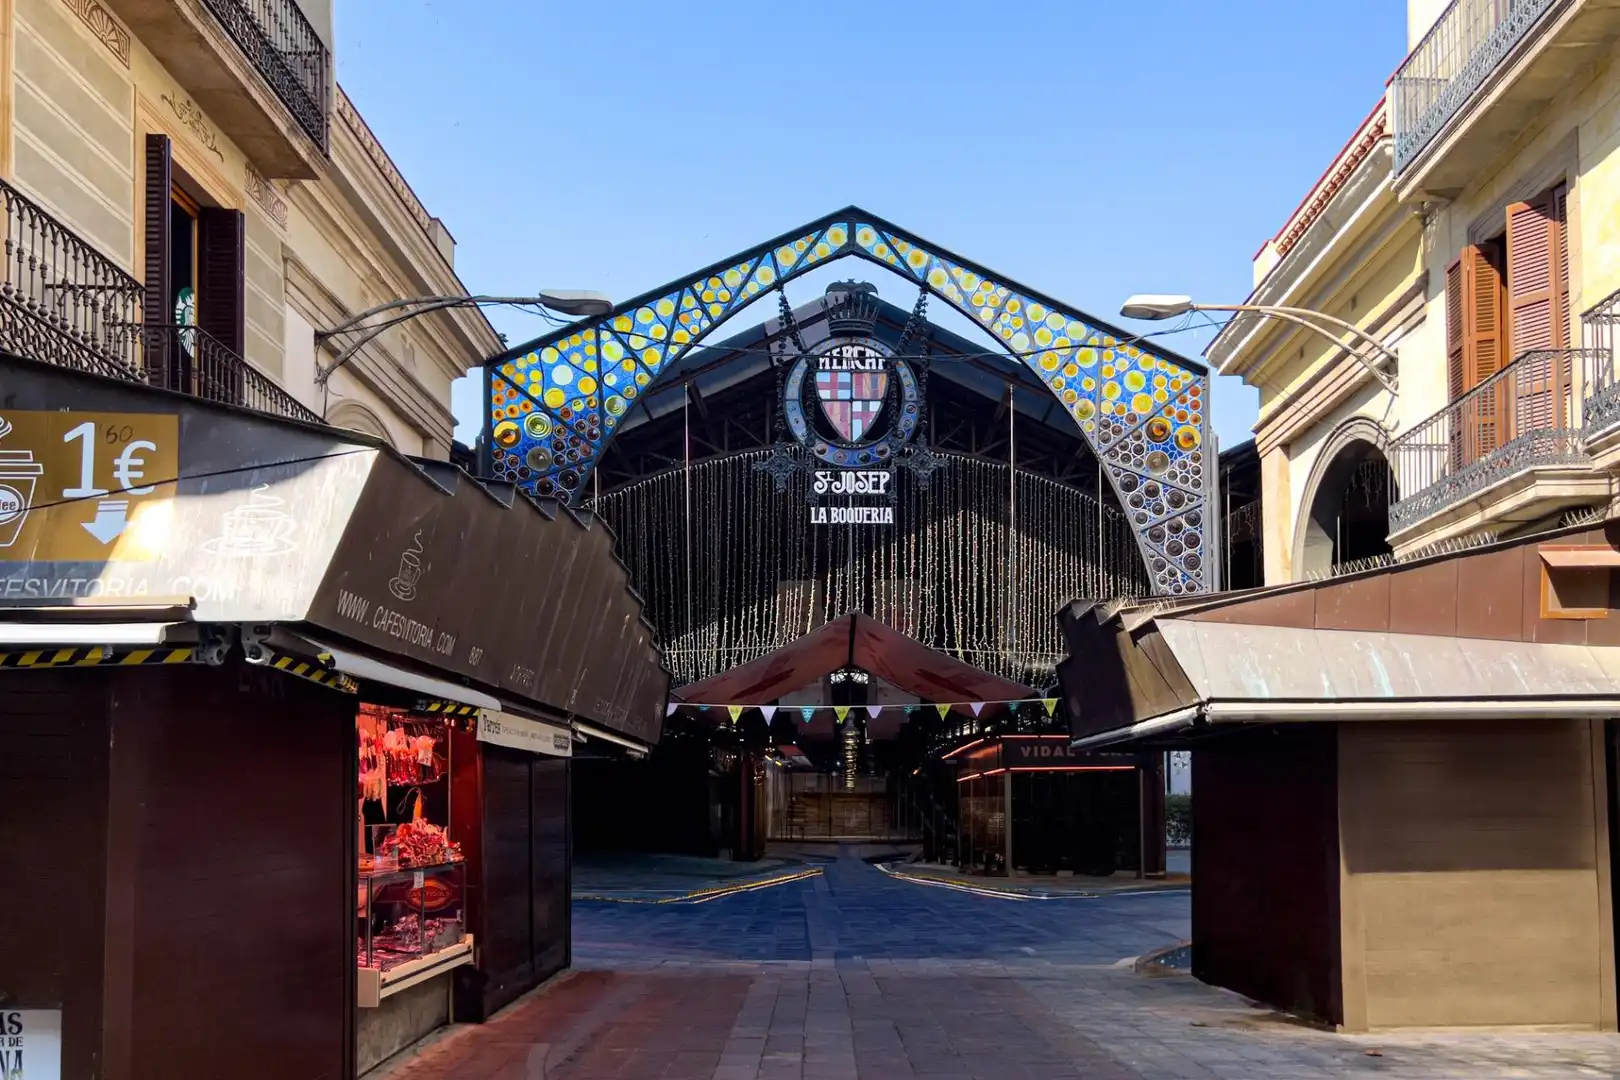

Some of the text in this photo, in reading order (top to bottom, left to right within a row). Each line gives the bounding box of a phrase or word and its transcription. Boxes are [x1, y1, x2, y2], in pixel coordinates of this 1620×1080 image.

[831, 471, 890, 494] JOSEP
[810, 507, 893, 524] LA BOQUERIA
[0, 578, 149, 598] ESVITORIA
[1020, 746, 1076, 758] VIDAL
[8, 1037, 23, 1047] DE
